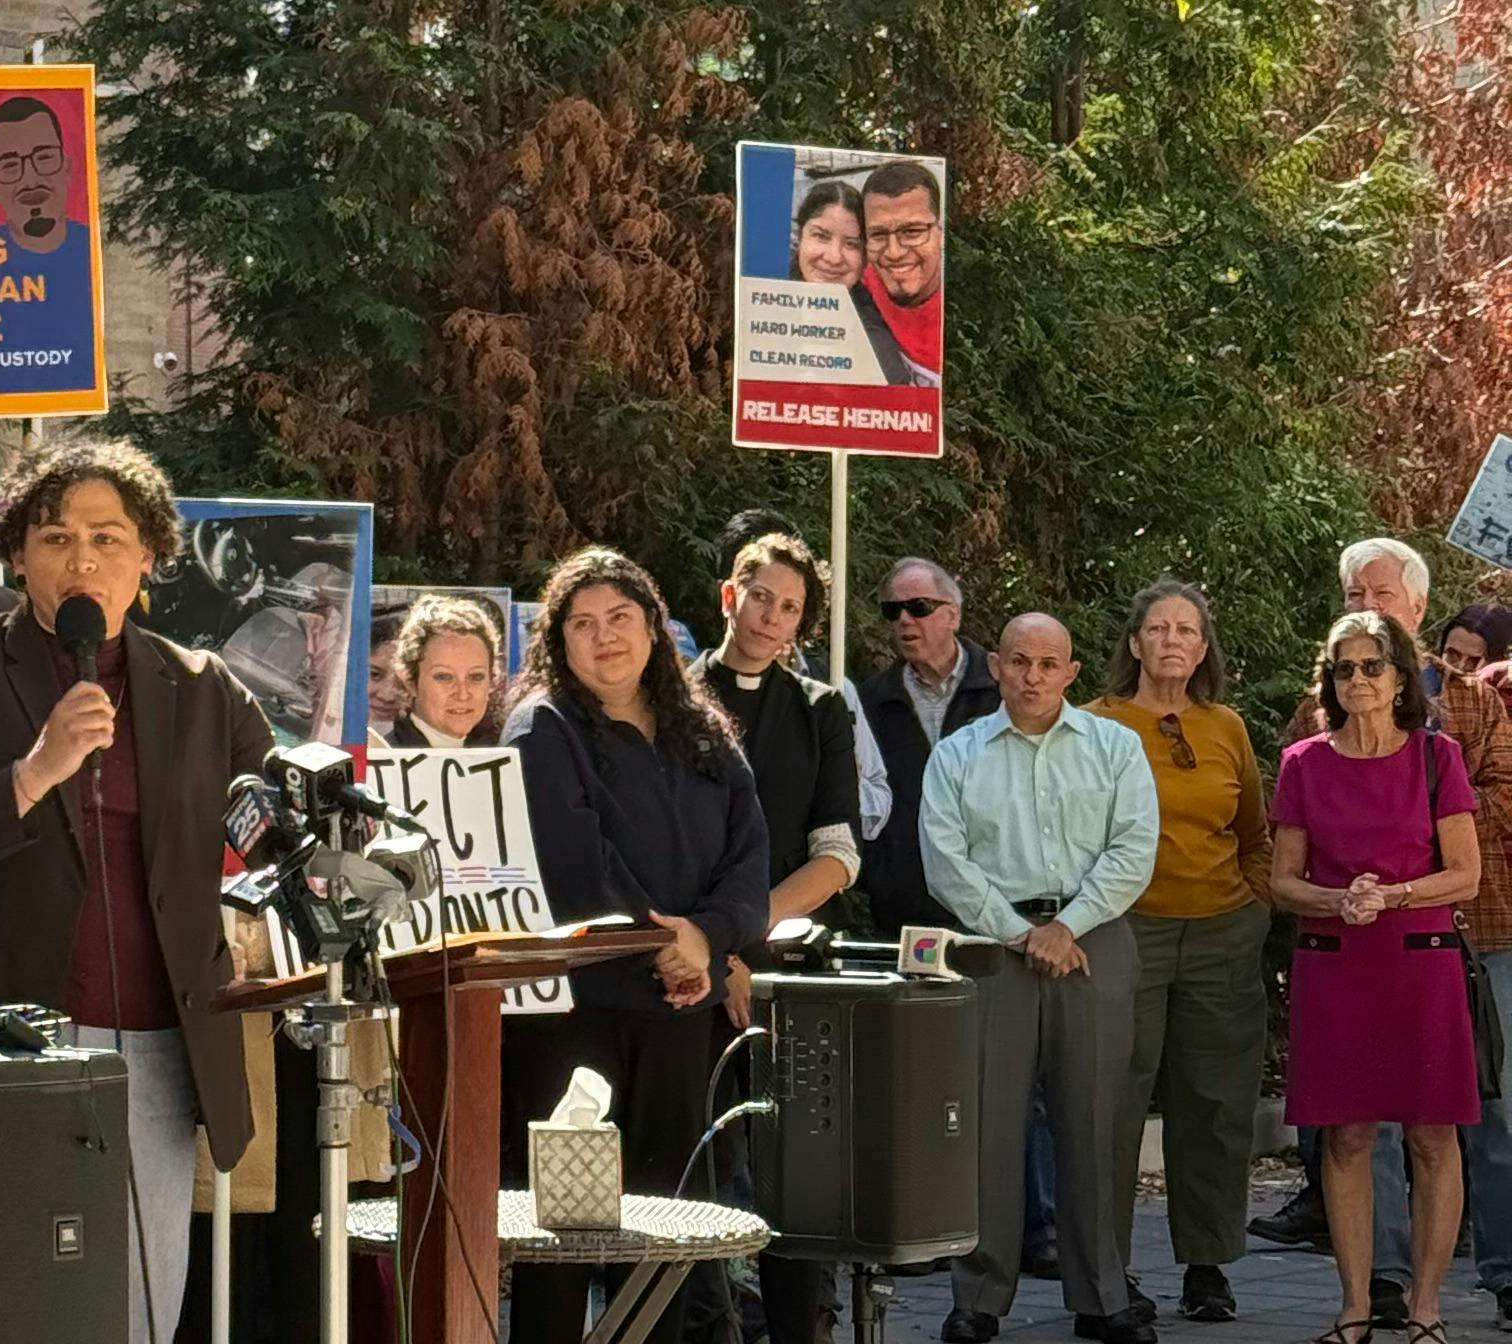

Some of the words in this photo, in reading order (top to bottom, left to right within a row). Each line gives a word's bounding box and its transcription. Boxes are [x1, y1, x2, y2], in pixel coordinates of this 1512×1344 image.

[750, 291, 804, 309] FAMILY
[807, 295, 840, 312] MAN
[750, 320, 788, 336] HARD
[790, 324, 847, 341] WORKER
[749, 349, 797, 367] CLEAN
[799, 353, 853, 371] RECORD
[742, 400, 840, 428] RELEASE
[842, 407, 933, 434] HERNAN!
